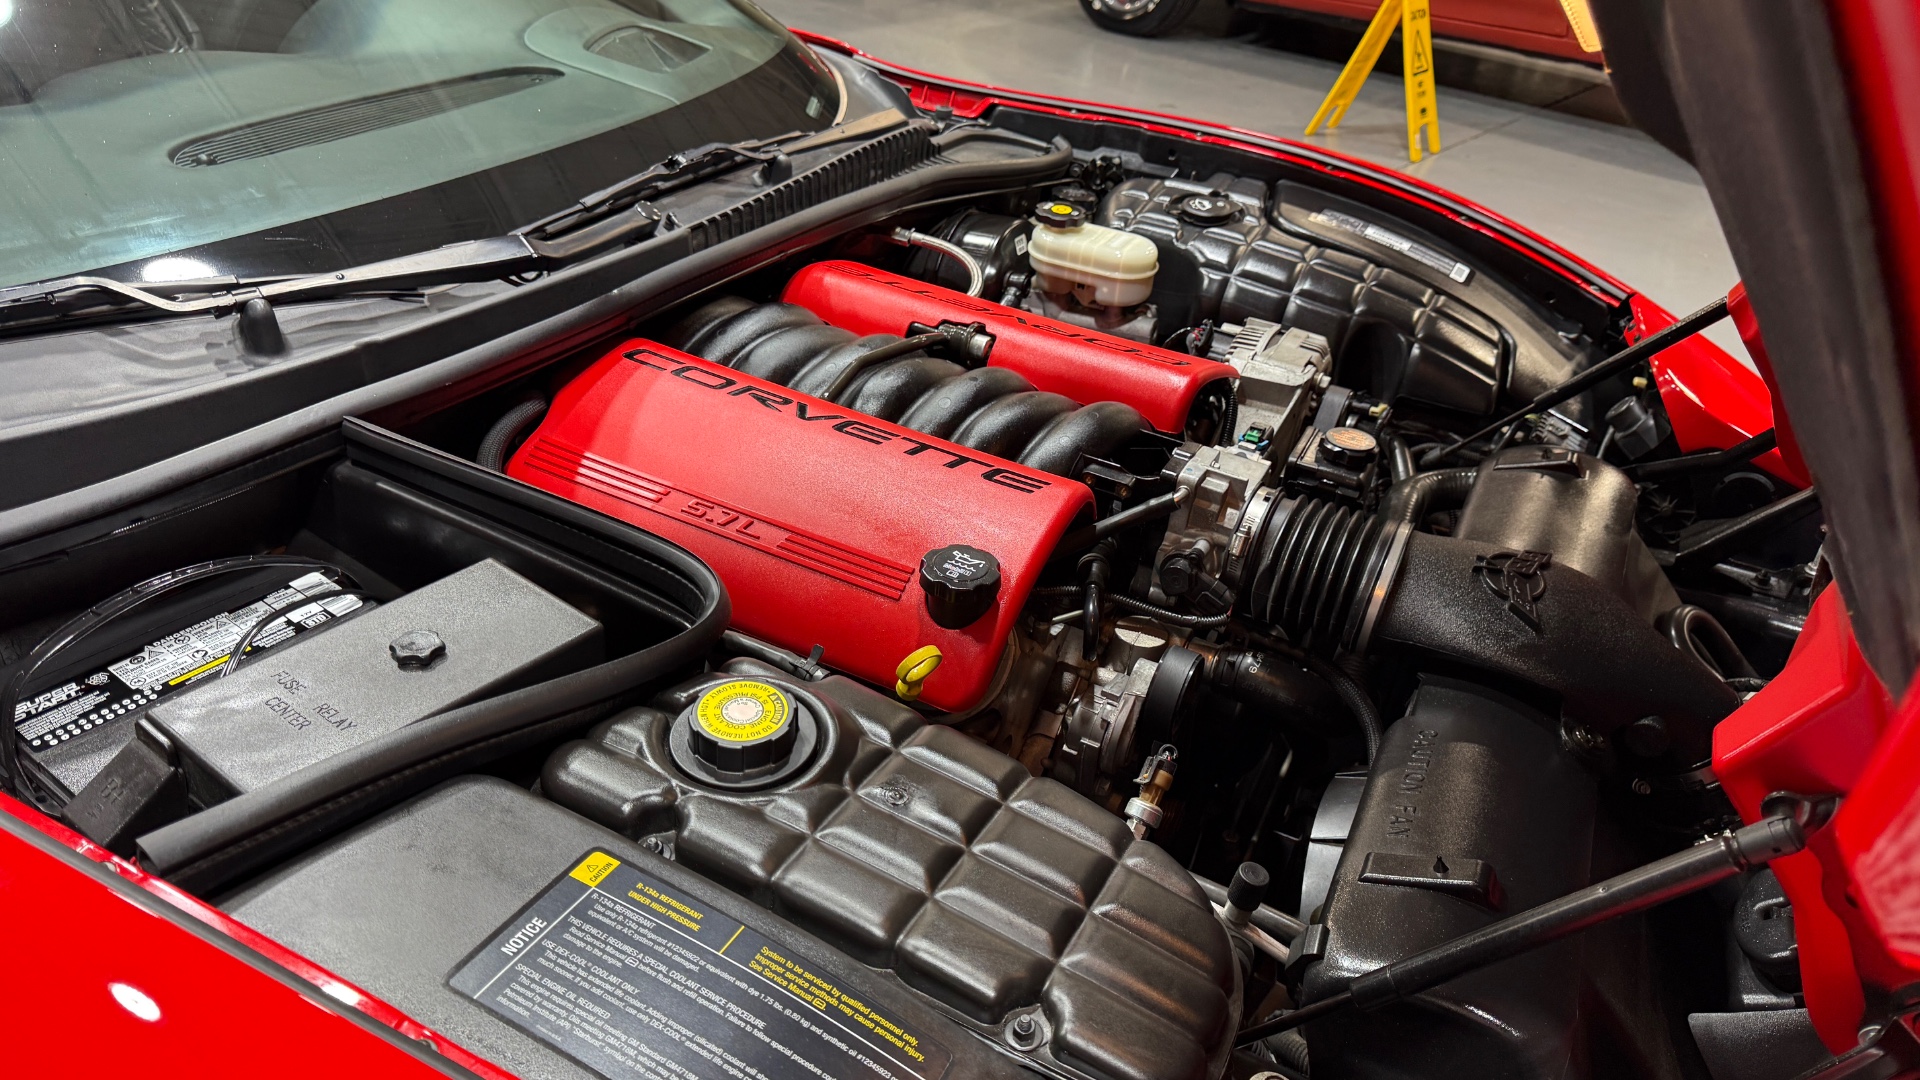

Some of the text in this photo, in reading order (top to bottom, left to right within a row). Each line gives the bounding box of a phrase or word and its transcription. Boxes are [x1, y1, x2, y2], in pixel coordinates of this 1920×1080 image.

[824, 264, 1193, 366] CORVETTE
[622, 347, 1053, 494] CORVETTE
[680, 499, 761, 539] 5.7L
[14, 686, 81, 723] START
[15, 682, 78, 713] SUPER
[264, 696, 312, 731] CENTER
[270, 670, 358, 732] FUSE RELAY
[1386, 729, 1439, 838] CAUTION FAN
[588, 861, 614, 882] CAUTION
[635, 882, 704, 920] R-134a REFRIGERANT
[499, 916, 548, 956] NOTICE
[587, 909, 617, 927] equivalent
[621, 927, 635, 935] A/C
[632, 933, 654, 947] system
[652, 943, 666, 952] will
[671, 954, 700, 973] damaged.
[590, 892, 656, 929] R-134a REFRIGERANT
[627, 890, 701, 931] UNDER HIGH PRESSURE
[541, 938, 557, 949] USE
[590, 965, 623, 985] COOLANT
[620, 981, 640, 995] ONLY
[562, 932, 587, 948] damage
[591, 947, 603, 956] the
[601, 954, 623, 969] engine.
[567, 915, 584, 926] THIS
[581, 922, 609, 940] VEHICLE
[606, 936, 639, 956] REQUIRES
[642, 955, 669, 974] SPECIAL
[668, 970, 701, 990] COOLANT
[698, 987, 728, 1006] SERVICE
[725, 1002, 767, 1029] PROCEDURE
[748, 960, 815, 1001] See Service Manual
[495, 994, 530, 1018] information.
[514, 963, 611, 1019] SPECIAL ENGINE OIL REQUIRED
[517, 974, 532, 985] This
[529, 982, 551, 997] engine
[549, 993, 575, 1011] requires
[573, 1007, 597, 1022] special
[602, 1023, 628, 1041] meeting
[627, 1037, 640, 1046] GM
[637, 1043, 667, 1063] Standard
[536, 956, 555, 968] much
[577, 980, 591, 990] you
[589, 986, 604, 995] add
[624, 1006, 637, 1014] use
[635, 1012, 651, 1023] only
[684, 1040, 714, 1059] extended
[711, 1056, 724, 1066] life
[721, 1063, 744, 1079] engine
[544, 950, 758, 1075] This vehicle has extended life Adding improper coolant will
[568, 926, 586, 937] Read
[583, 934, 606, 948] Service
[604, 945, 628, 960] Manual
[637, 963, 658, 976] before
[656, 973, 672, 984] flush
[670, 982, 684, 991] and
[682, 988, 698, 999] refill
[695, 996, 725, 1016] operation.
[724, 1012, 746, 1027] Failure
[751, 1028, 772, 1043] follow
[769, 1040, 793, 1056] special
[790, 1053, 823, 1075] procedure
[593, 903, 606, 912] Use
[604, 909, 618, 919] only
[616, 915, 639, 929] R-134a
[637, 926, 668, 945] refrigerant
[705, 963, 736, 983] equivalent
[734, 979, 749, 990] with
[747, 987, 760, 997] dye
[759, 994, 774, 1004] 1.75
[799, 1018, 811, 1028] kg)
[809, 1024, 823, 1035] and
[821, 1032, 849, 1052] synthetic
[847, 1048, 858, 1056] oil
[856, 1054, 892, 1078] #12345923
[754, 953, 925, 1063] Improper service methods may cause personal injury.
[760, 946, 919, 1047] System to be serviced by qualified personnel only.
[502, 988, 534, 1008] Petroleum
[531, 1004, 557, 1021] Institute
[602, 1045, 627, 1062] symbol
[633, 1063, 646, 1073] the
[509, 982, 535, 997] covered
[532, 994, 543, 1003] by
[579, 1021, 606, 1039] meeting
[636, 1054, 657, 1068] which
[655, 1066, 671, 1077] may
